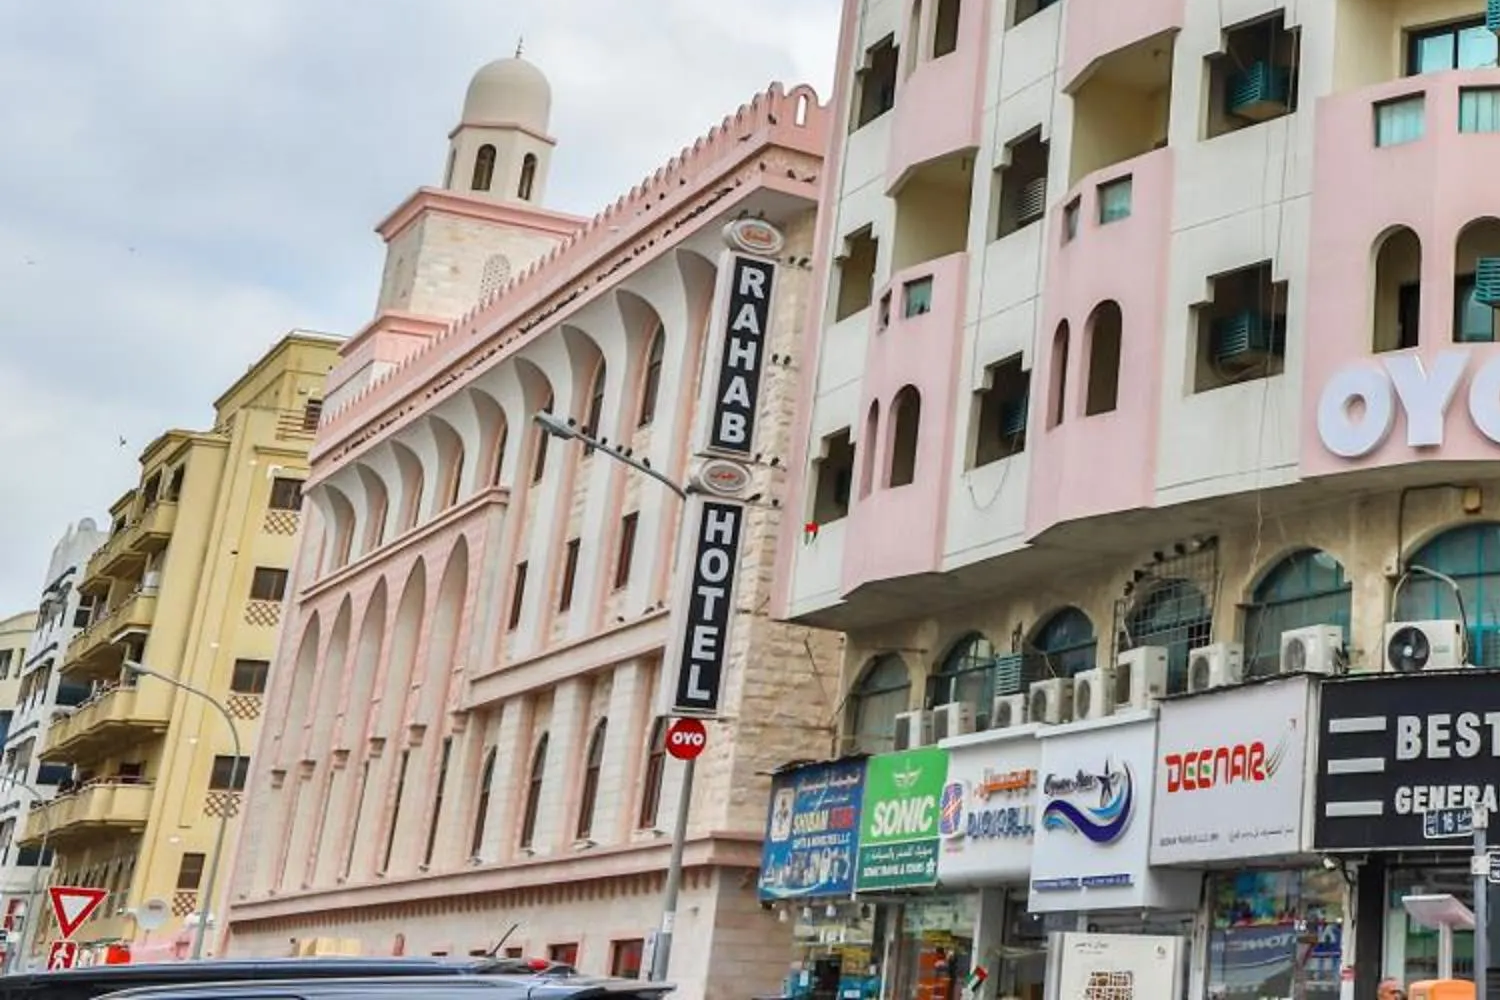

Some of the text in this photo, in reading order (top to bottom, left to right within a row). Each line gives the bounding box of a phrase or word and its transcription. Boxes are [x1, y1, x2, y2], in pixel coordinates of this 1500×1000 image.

[719, 266, 766, 444] RAHAB
[687, 509, 735, 700] HOTEL
[672, 731, 704, 746] OYO
[1165, 741, 1265, 793] DEENAR
[871, 795, 935, 837] SONIC
